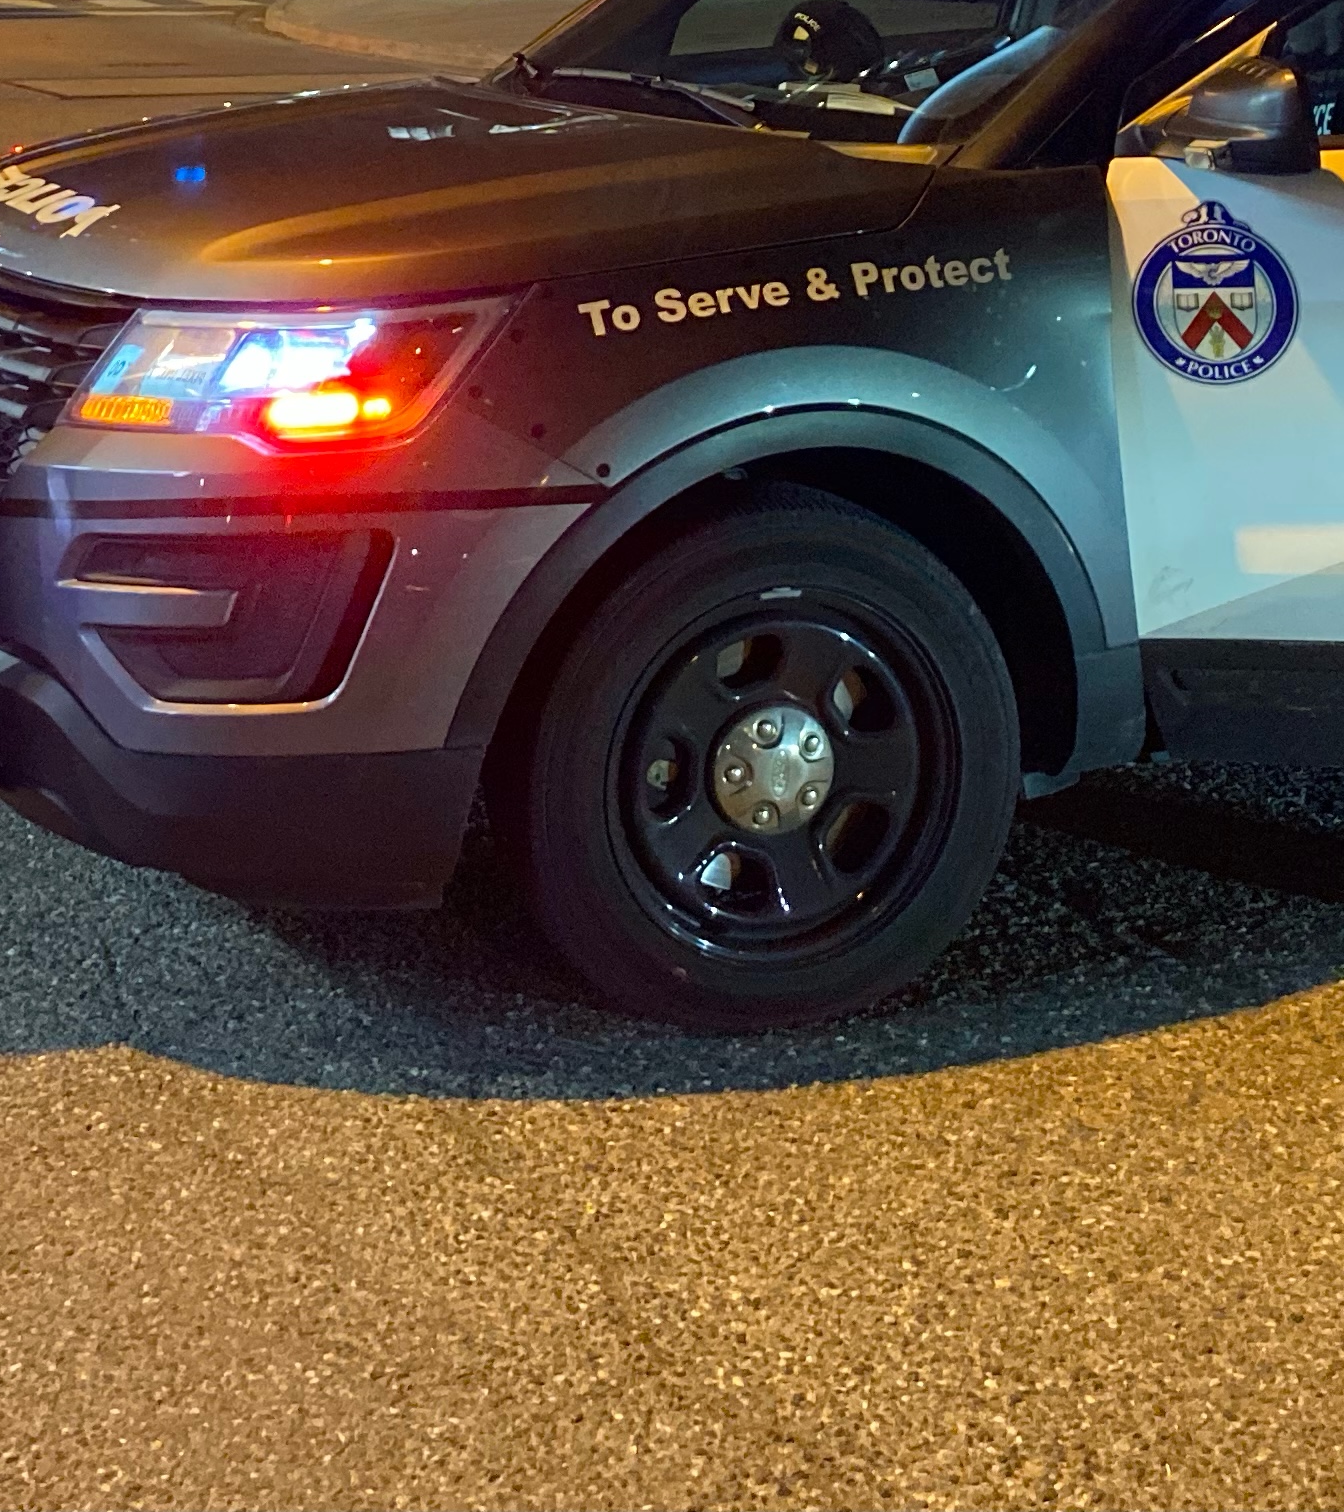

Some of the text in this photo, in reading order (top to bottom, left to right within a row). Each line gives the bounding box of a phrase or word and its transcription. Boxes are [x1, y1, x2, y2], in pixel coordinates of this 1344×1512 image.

[794, 12, 821, 32] POLICE
[1167, 229, 1256, 254] TORONTO
[578, 247, 1013, 336] To Serve & Protect
[1187, 360, 1253, 380] POLICE
